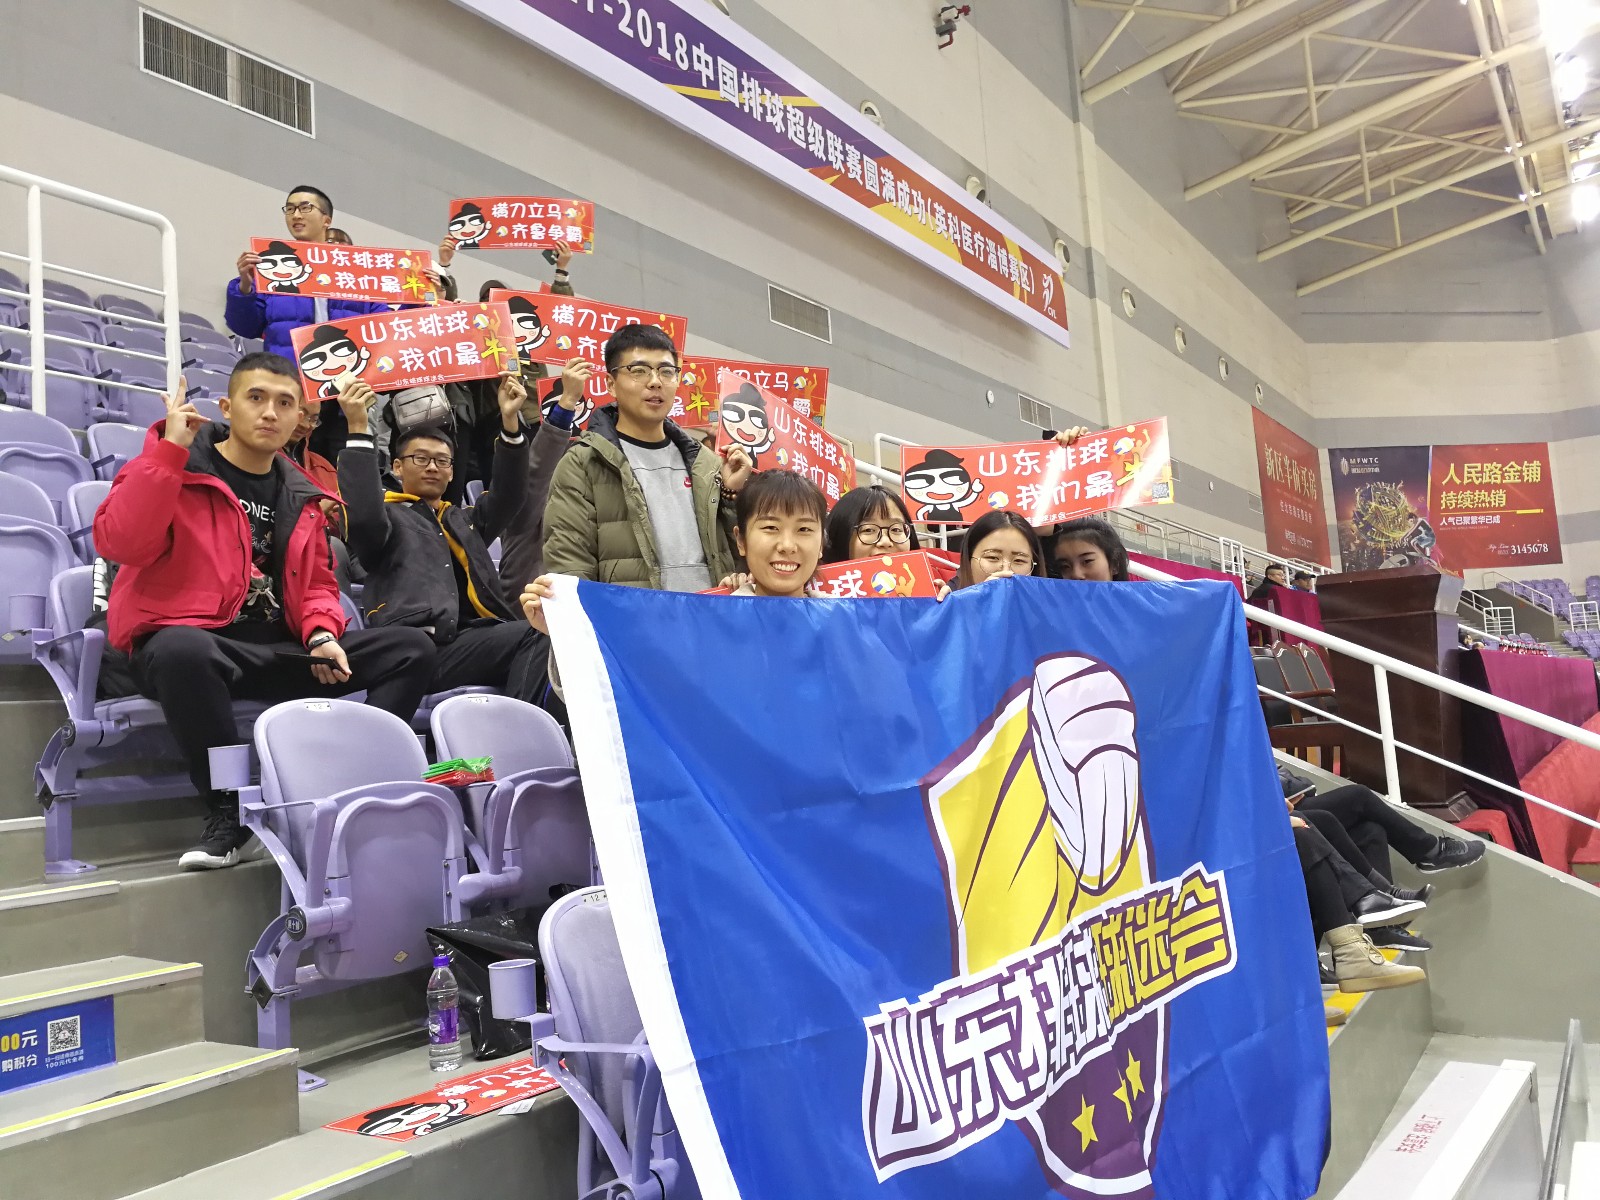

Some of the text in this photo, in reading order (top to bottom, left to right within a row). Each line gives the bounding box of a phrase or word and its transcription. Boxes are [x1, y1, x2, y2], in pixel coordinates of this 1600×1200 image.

[577, 0, 1034, 295] -2018中国排球超级联赛圆满成功(英科医疗淄博赛区)
[491, 202, 562, 220] 横刀立马
[512, 223, 583, 244] 齐鲁争霸
[306, 246, 395, 270] 山东排球
[334, 271, 428, 298] 我们最牛
[360, 310, 470, 344] 山东排球
[399, 331, 509, 373] 我们最牛
[774, 406, 838, 466] 山东排球
[978, 436, 1109, 477] 山东排球
[791, 449, 851, 501] 我们最
[1441, 460, 1542, 487] 人民路金铺
[1440, 489, 1507, 510] 持续热销
[1511, 543, 1549, 555] 3145678
[1, 1053, 38, 1073] 购积分
